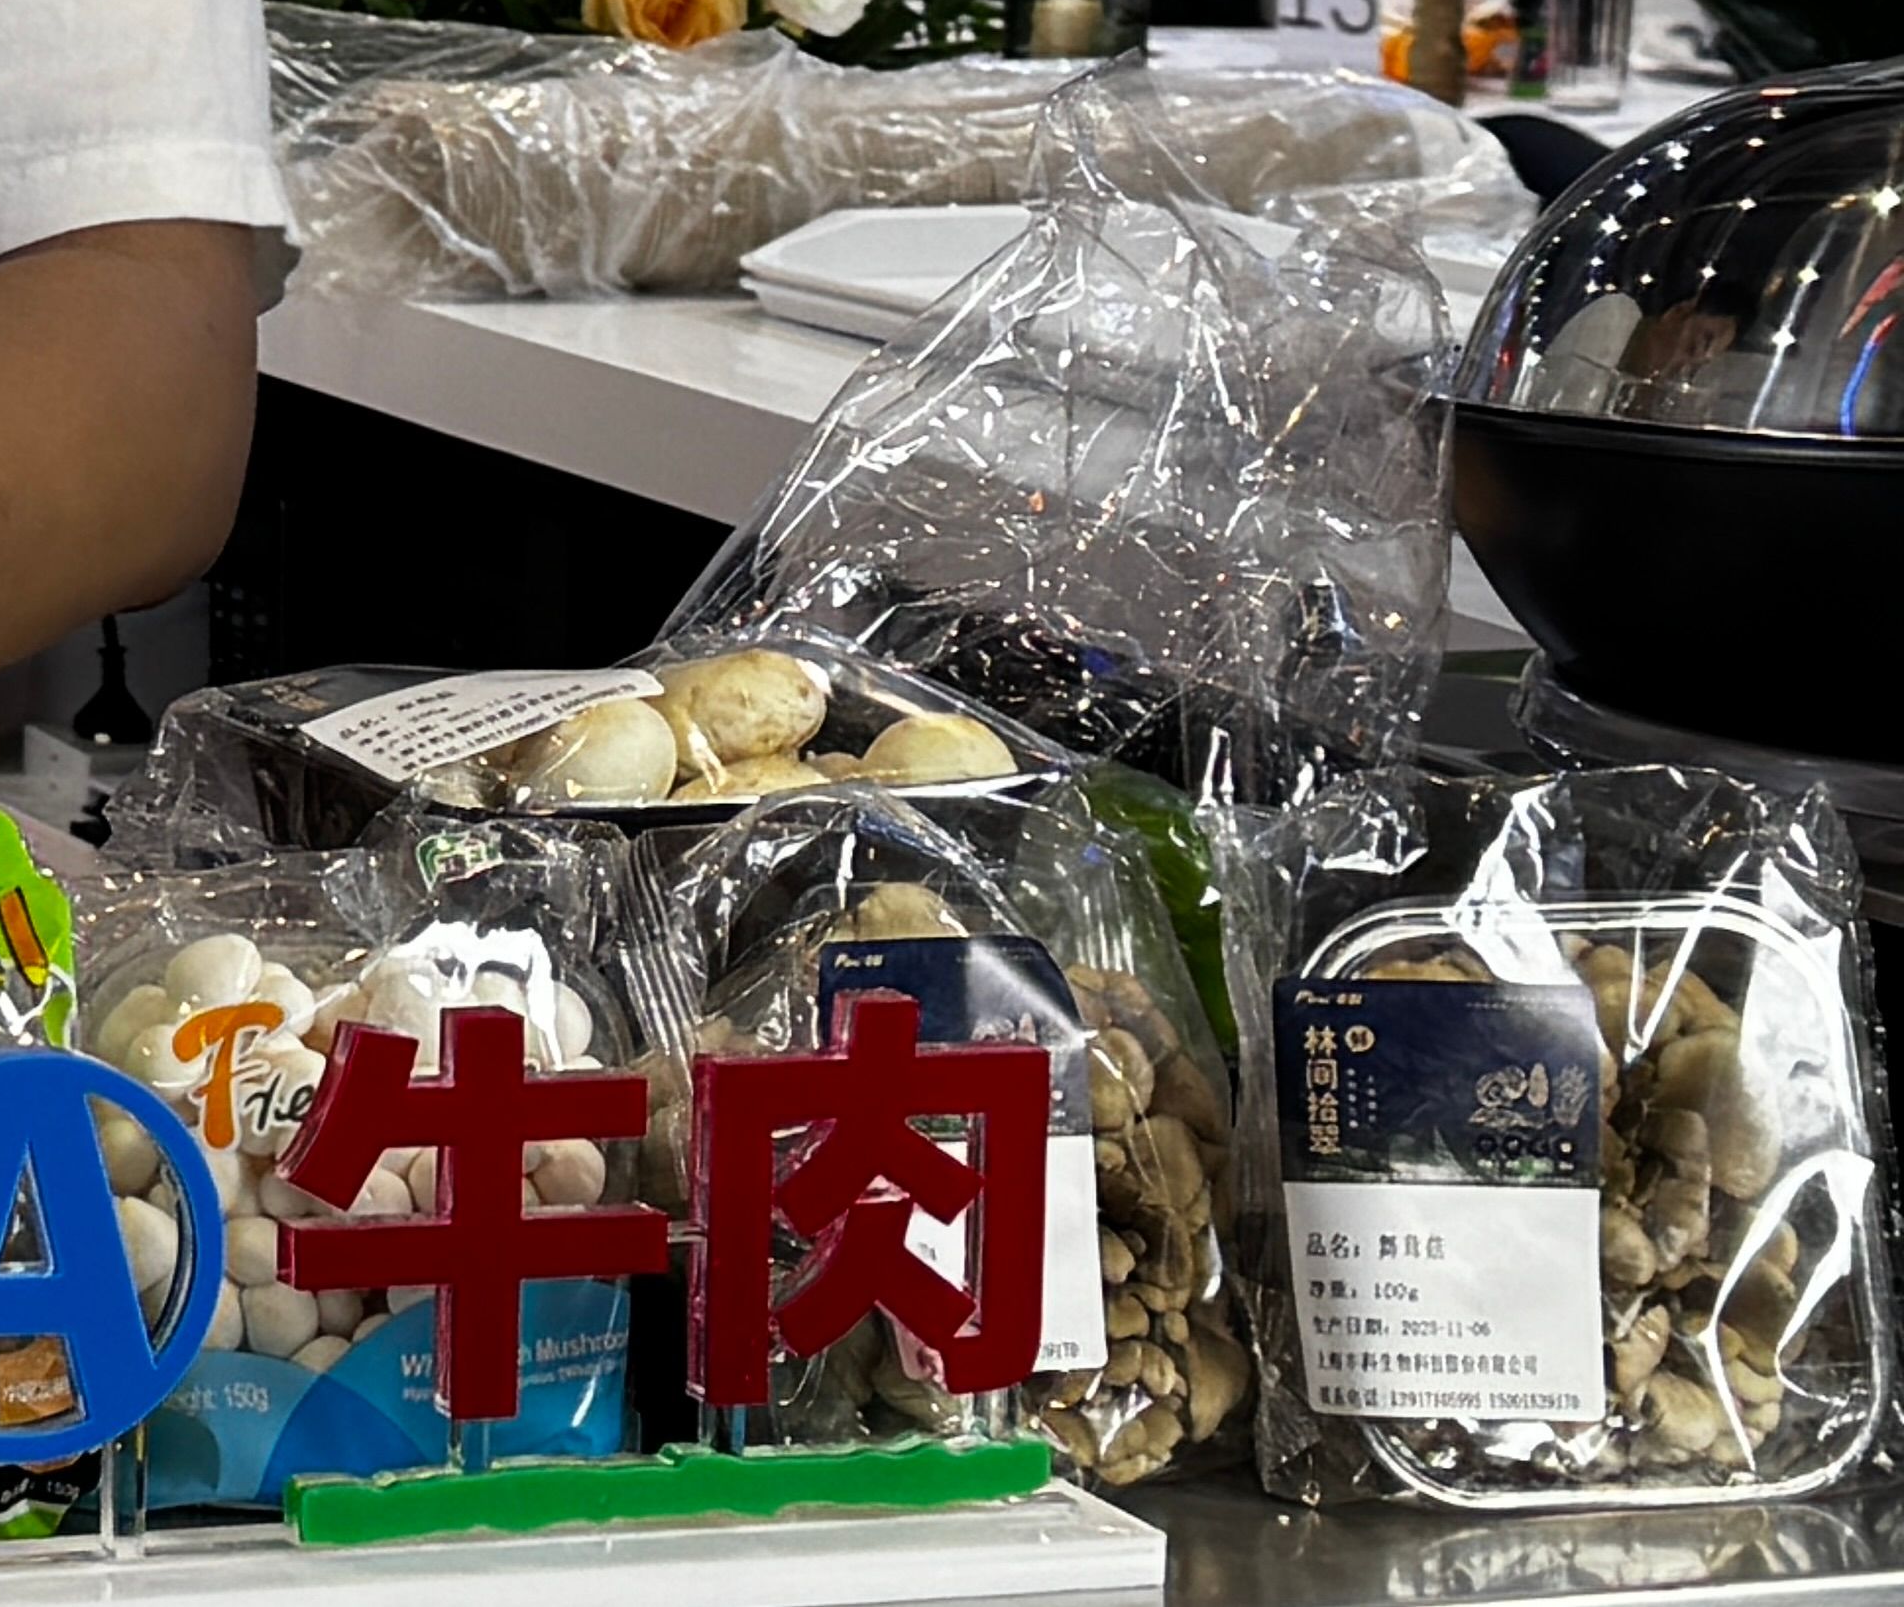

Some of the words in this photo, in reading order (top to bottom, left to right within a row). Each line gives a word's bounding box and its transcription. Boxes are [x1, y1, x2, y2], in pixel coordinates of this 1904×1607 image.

[278, 990, 1052, 1419] 牛肉
[1374, 1282, 1419, 1303] 100g
[535, 1332, 626, 1362] Mushroo
[223, 1382, 270, 1413] 150g
